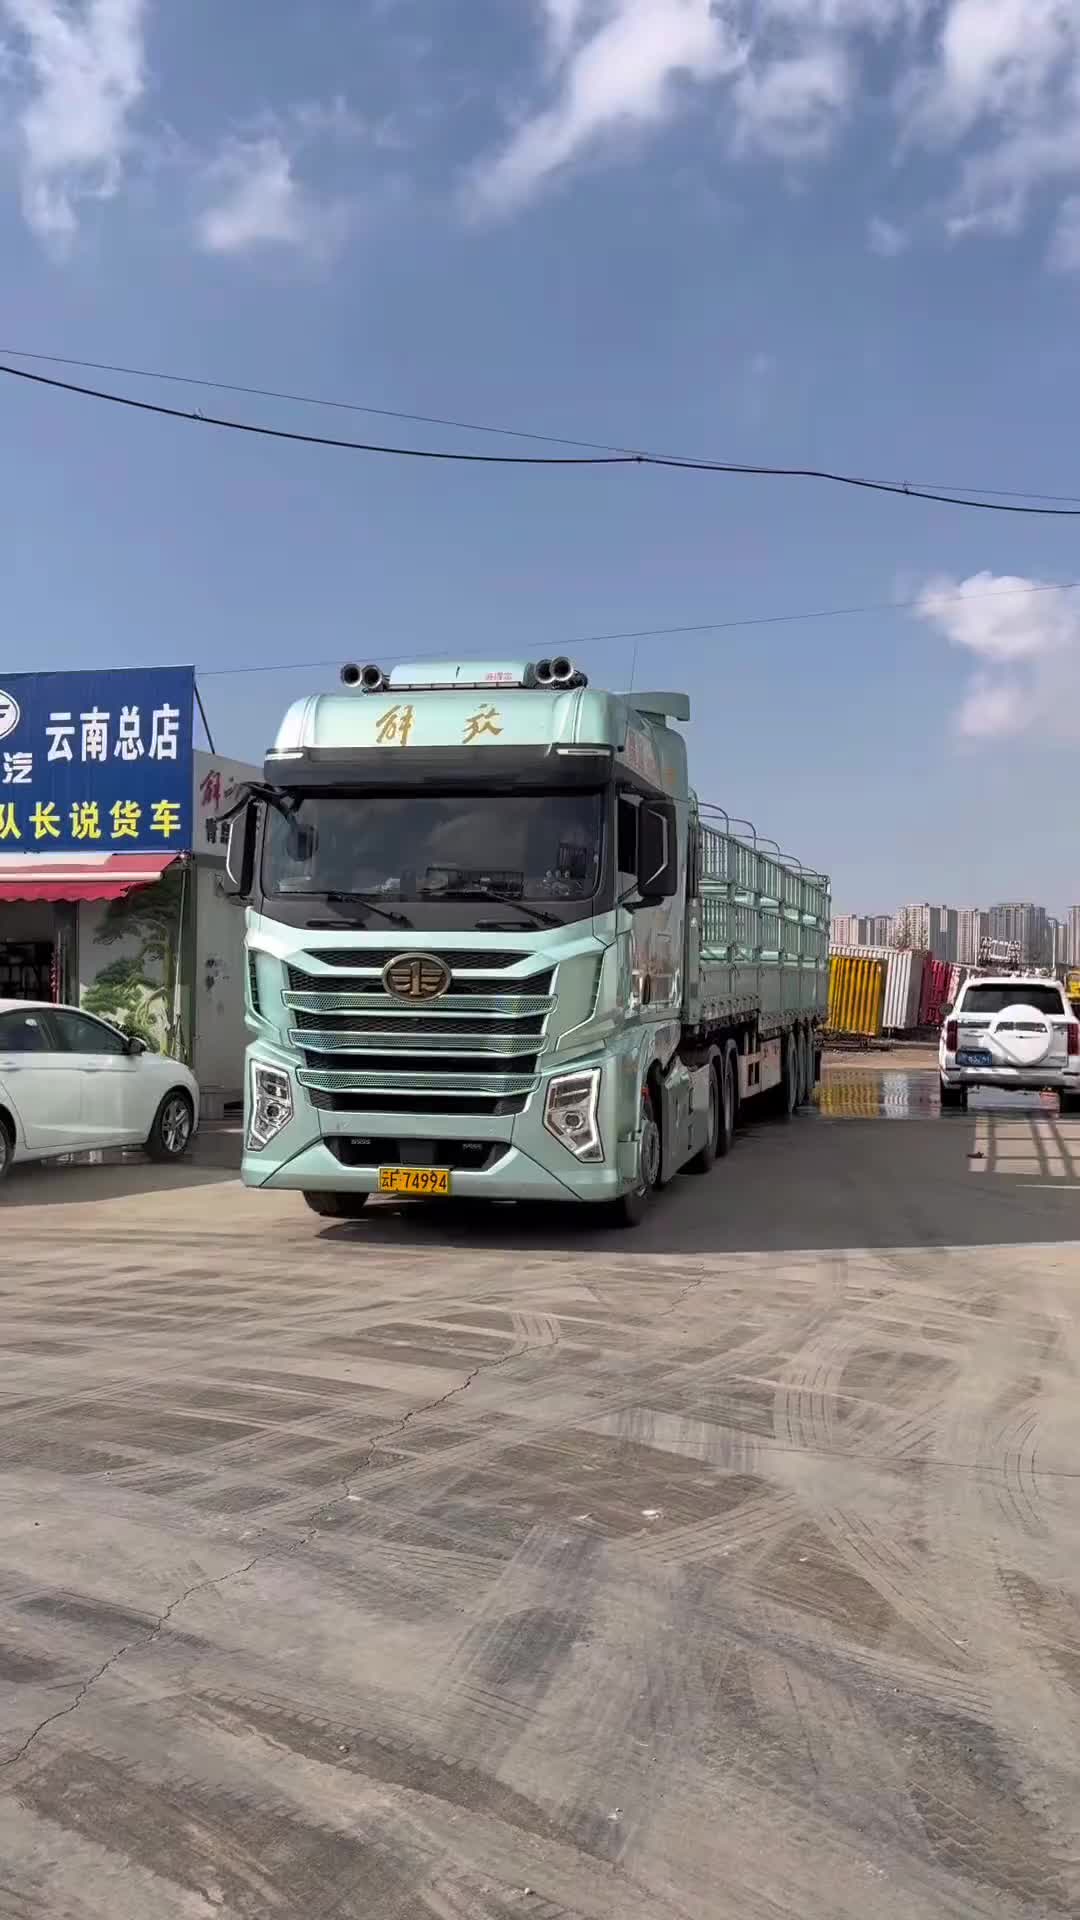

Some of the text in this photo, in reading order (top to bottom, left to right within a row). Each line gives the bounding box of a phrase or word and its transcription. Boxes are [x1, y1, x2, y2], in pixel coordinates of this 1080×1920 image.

[45, 703, 180, 762] 云南总店
[2, 752, 33, 784] 汽
[0, 800, 182, 840] 队长说货车
